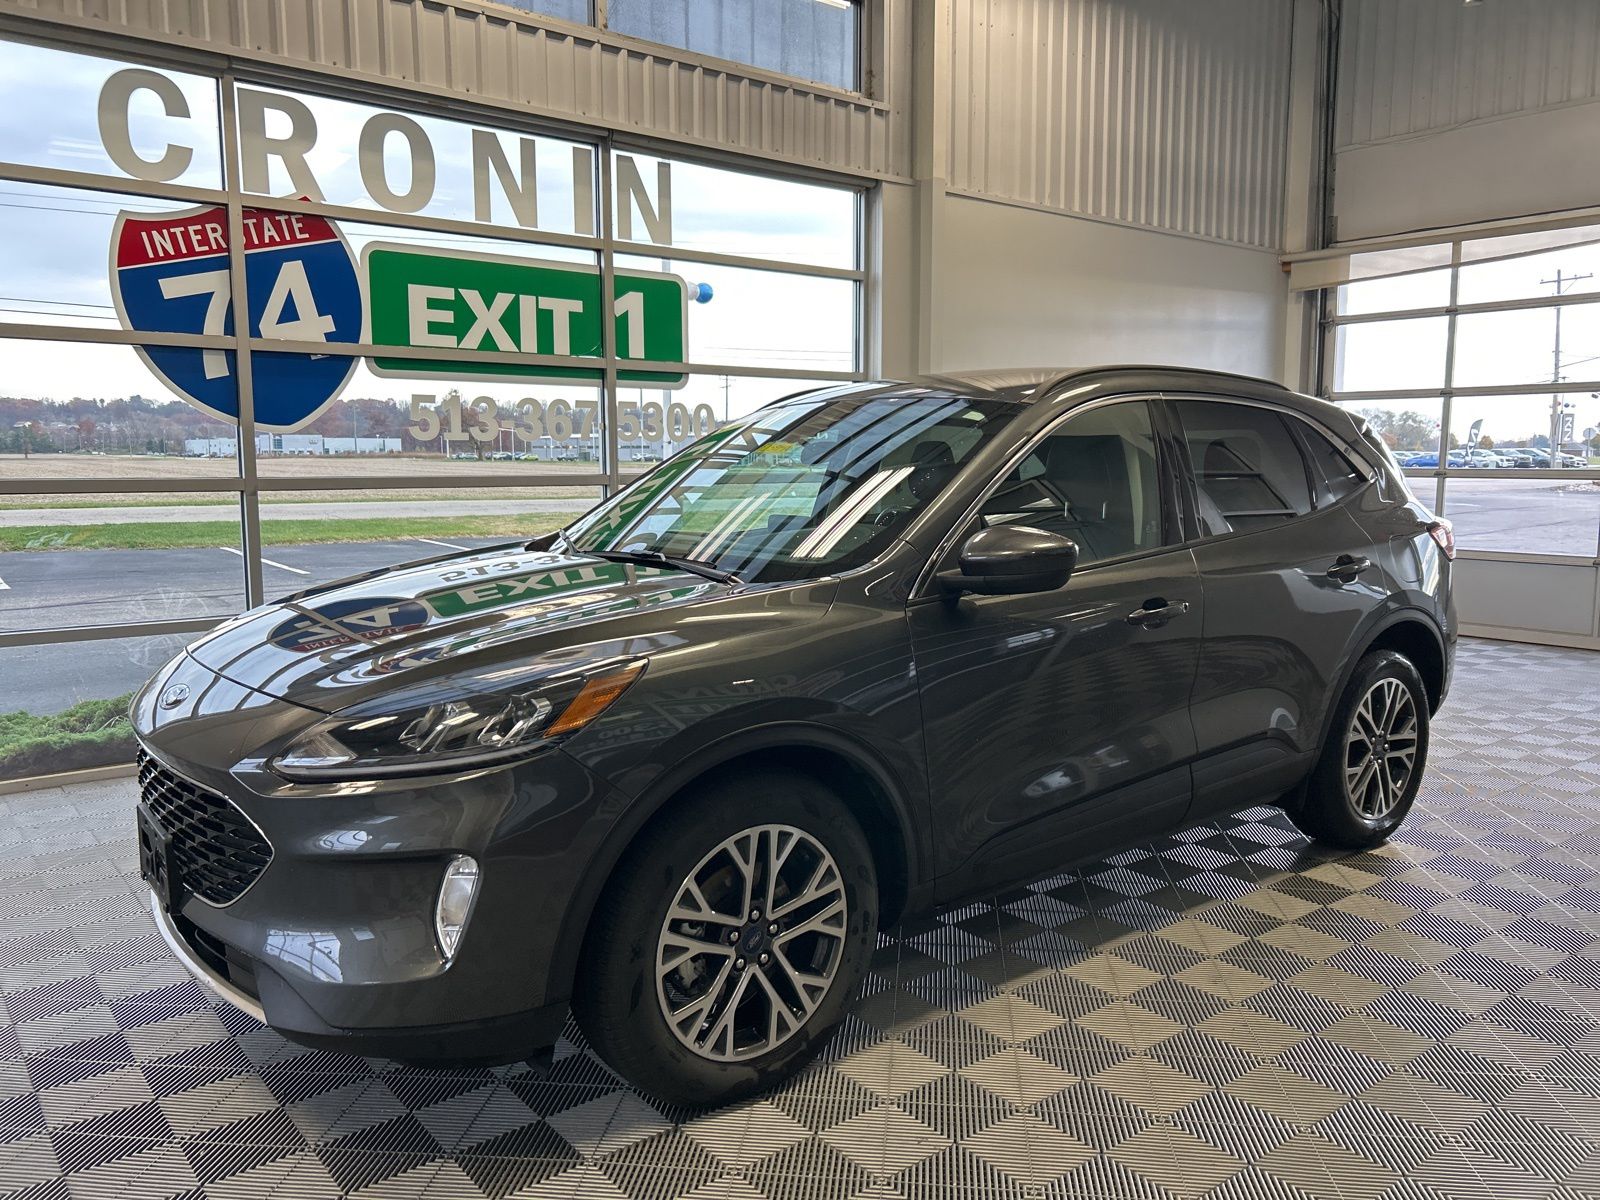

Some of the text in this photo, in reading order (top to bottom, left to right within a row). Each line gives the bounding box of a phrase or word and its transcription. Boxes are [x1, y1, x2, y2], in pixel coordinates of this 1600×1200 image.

[98, 68, 672, 246] CRONIN
[158, 260, 336, 380] 74
[407, 283, 645, 359] EXIT 1
[408, 393, 716, 443] 513-3675300
